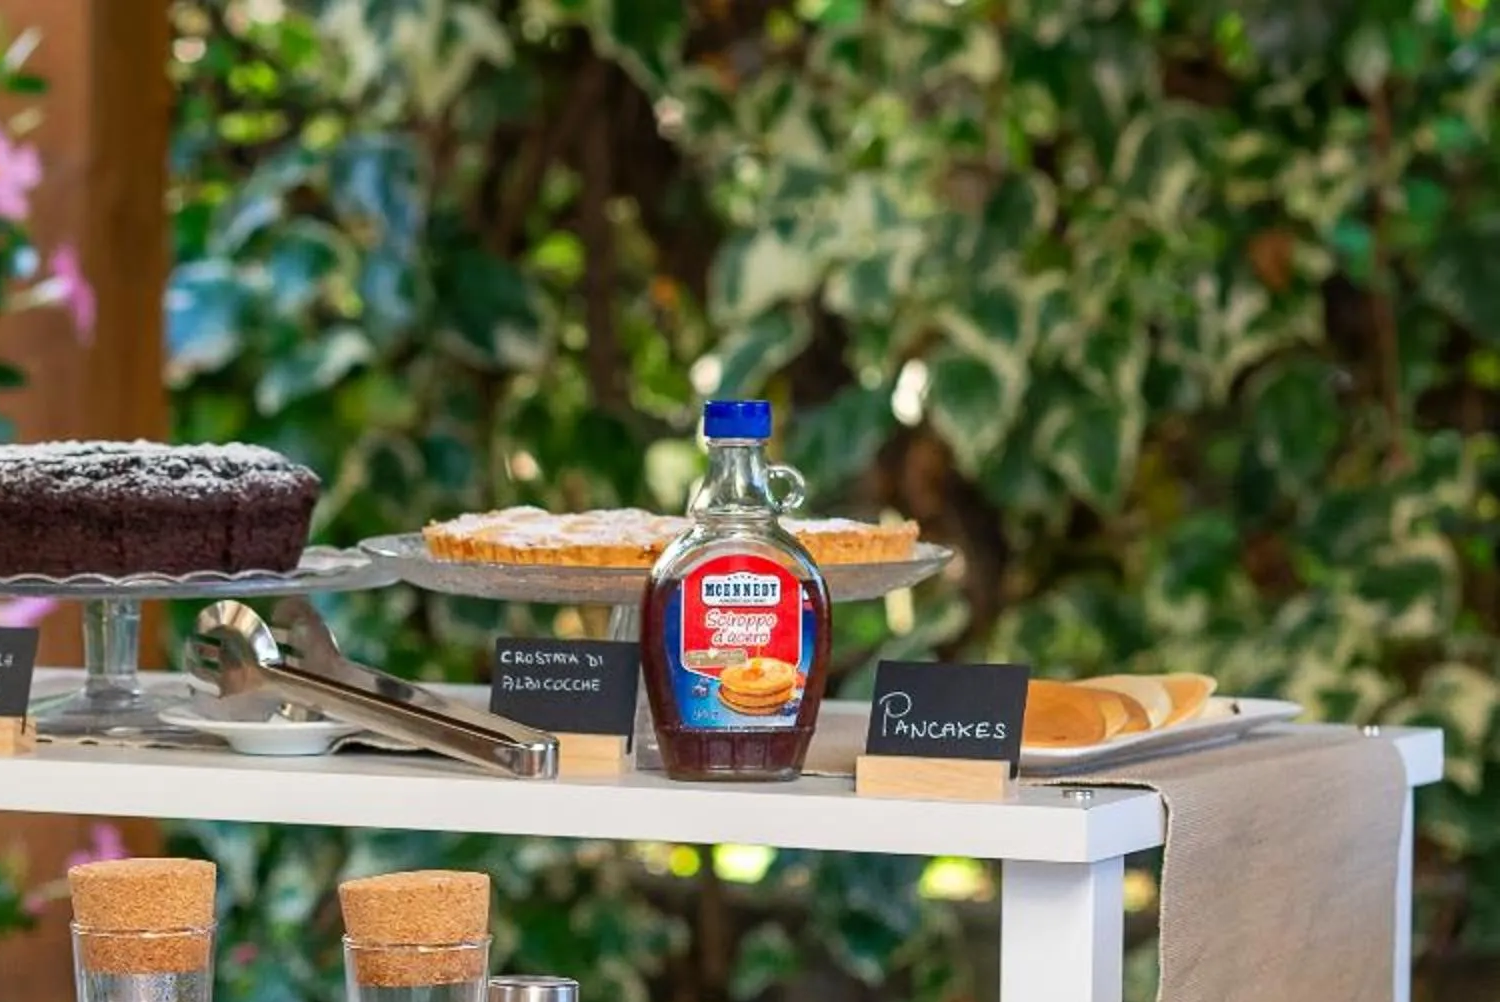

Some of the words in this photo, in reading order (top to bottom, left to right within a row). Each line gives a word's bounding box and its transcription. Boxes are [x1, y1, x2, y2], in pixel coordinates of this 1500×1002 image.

[706, 609, 777, 631] Sciroppo
[500, 650, 580, 666] CROSTATA
[586, 653, 604, 667] DI
[502, 675, 602, 692] ALBICOCCHE
